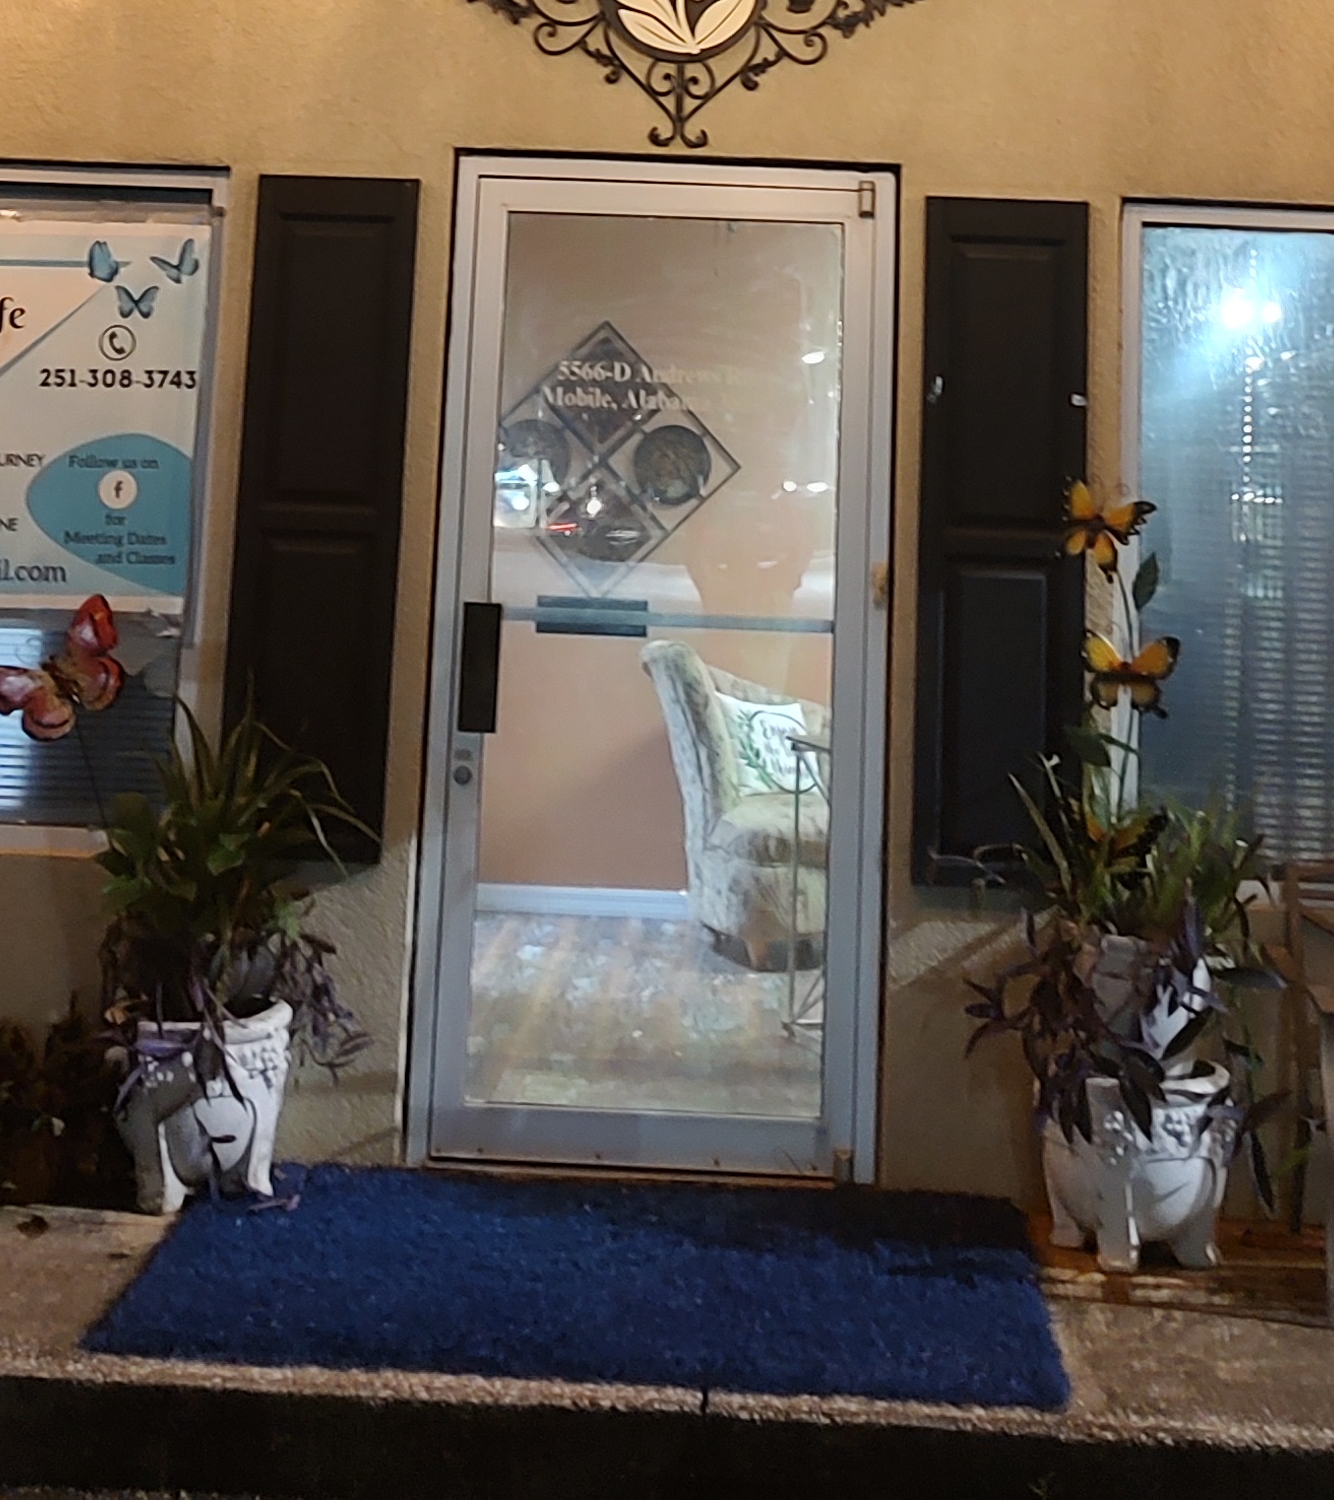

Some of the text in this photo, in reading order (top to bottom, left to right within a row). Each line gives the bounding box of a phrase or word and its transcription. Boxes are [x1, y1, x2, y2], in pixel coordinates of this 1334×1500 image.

[38, 367, 198, 390] 251-308-3743
[556, 359, 633, 383] 5566-D
[541, 384, 617, 410] Mobile,
[68, 454, 119, 470] Follow
[140, 457, 160, 470] on
[63, 529, 124, 547] Meeting
